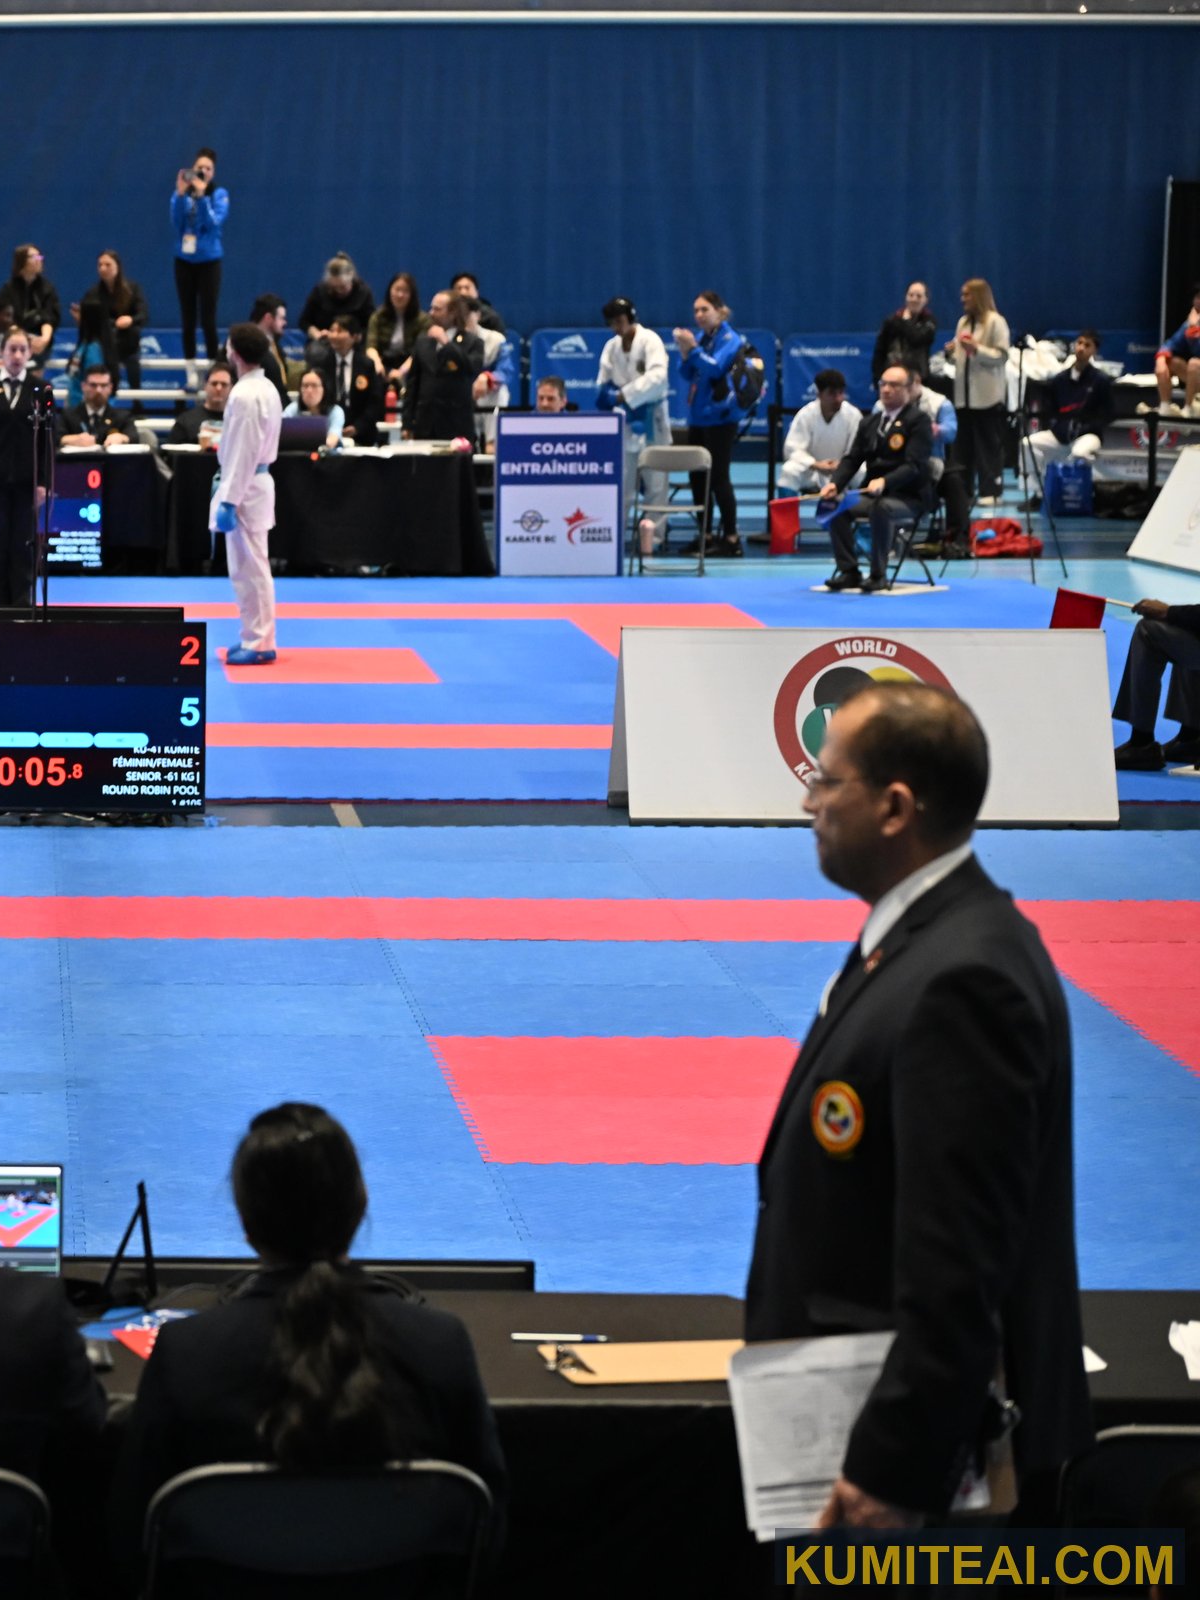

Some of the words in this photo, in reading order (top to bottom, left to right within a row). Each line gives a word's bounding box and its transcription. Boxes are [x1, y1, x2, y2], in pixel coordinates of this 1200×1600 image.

[530, 442, 588, 456] COACH
[88, 470, 101, 488] 0
[87, 503, 101, 522] 8
[505, 535, 542, 543] KARATE
[544, 535, 557, 543] BC
[180, 636, 200, 665] 2
[834, 639, 898, 658] WORLD
[180, 697, 200, 727] 5
[112, 756, 193, 768] FÉMININ/FEMALE
[125, 771, 162, 782] SENIOR
[163, 771, 179, 782] -61
[180, 771, 195, 782] KG
[102, 785, 139, 795] ROUND
[140, 785, 171, 795] ROBIN
[173, 785, 200, 795] POOL
